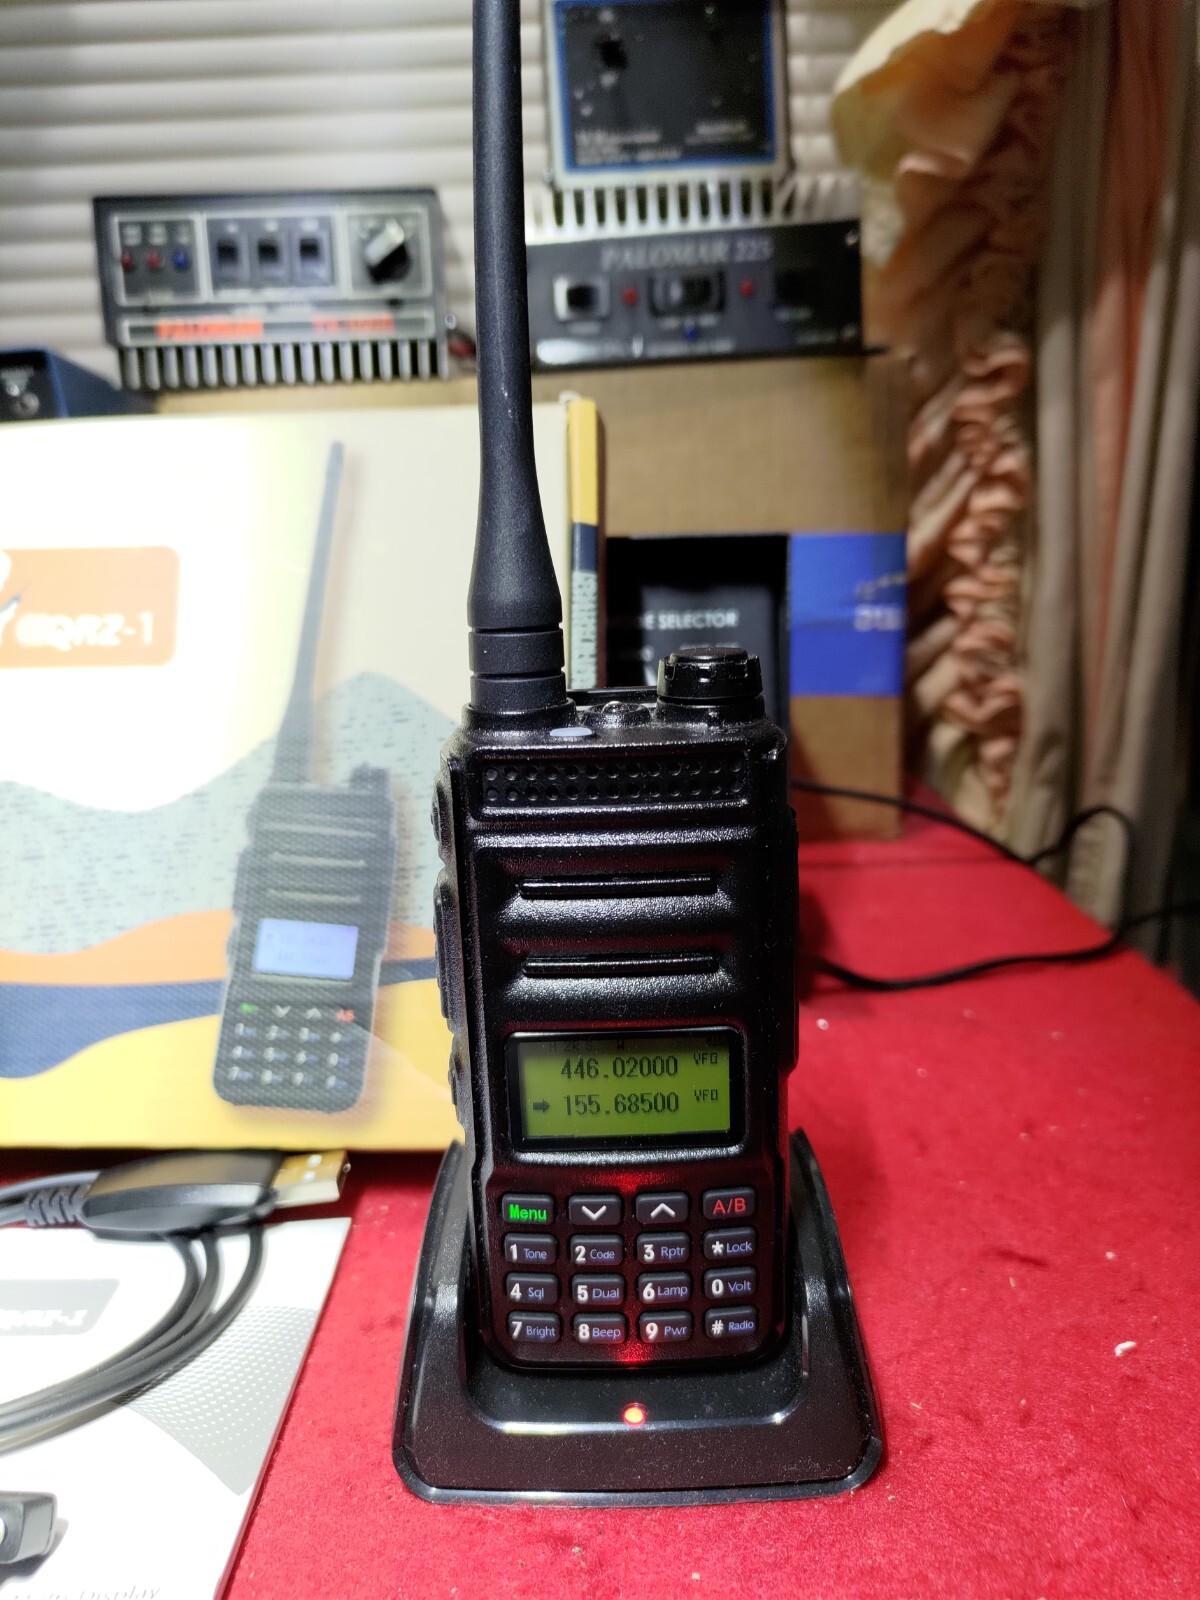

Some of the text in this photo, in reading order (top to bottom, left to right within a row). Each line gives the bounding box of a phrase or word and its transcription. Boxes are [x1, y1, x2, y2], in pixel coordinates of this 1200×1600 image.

[658, 610, 739, 630] SELECTOR
[561, 1052, 718, 1079] 446.02000 VFO
[563, 1089, 718, 1116] 155.68500 VFO
[509, 1204, 547, 1221] Menu
[713, 1197, 746, 1215] A/B
[510, 1244, 547, 1261] 1 Tone
[575, 1246, 615, 1263] 2 Code
[643, 1244, 685, 1261] 3 Rptr
[726, 1241, 752, 1252] Lock
[510, 1283, 544, 1299] 4 Sql
[577, 1285, 619, 1301] 5 Dual
[643, 1283, 688, 1300] 6 Lamp
[712, 1279, 751, 1295] 0 Volt
[511, 1321, 555, 1339] 7 Bright
[578, 1324, 620, 1341] 8 Beep
[645, 1323, 686, 1339] 9 Pwr
[728, 1320, 754, 1331] Radio
